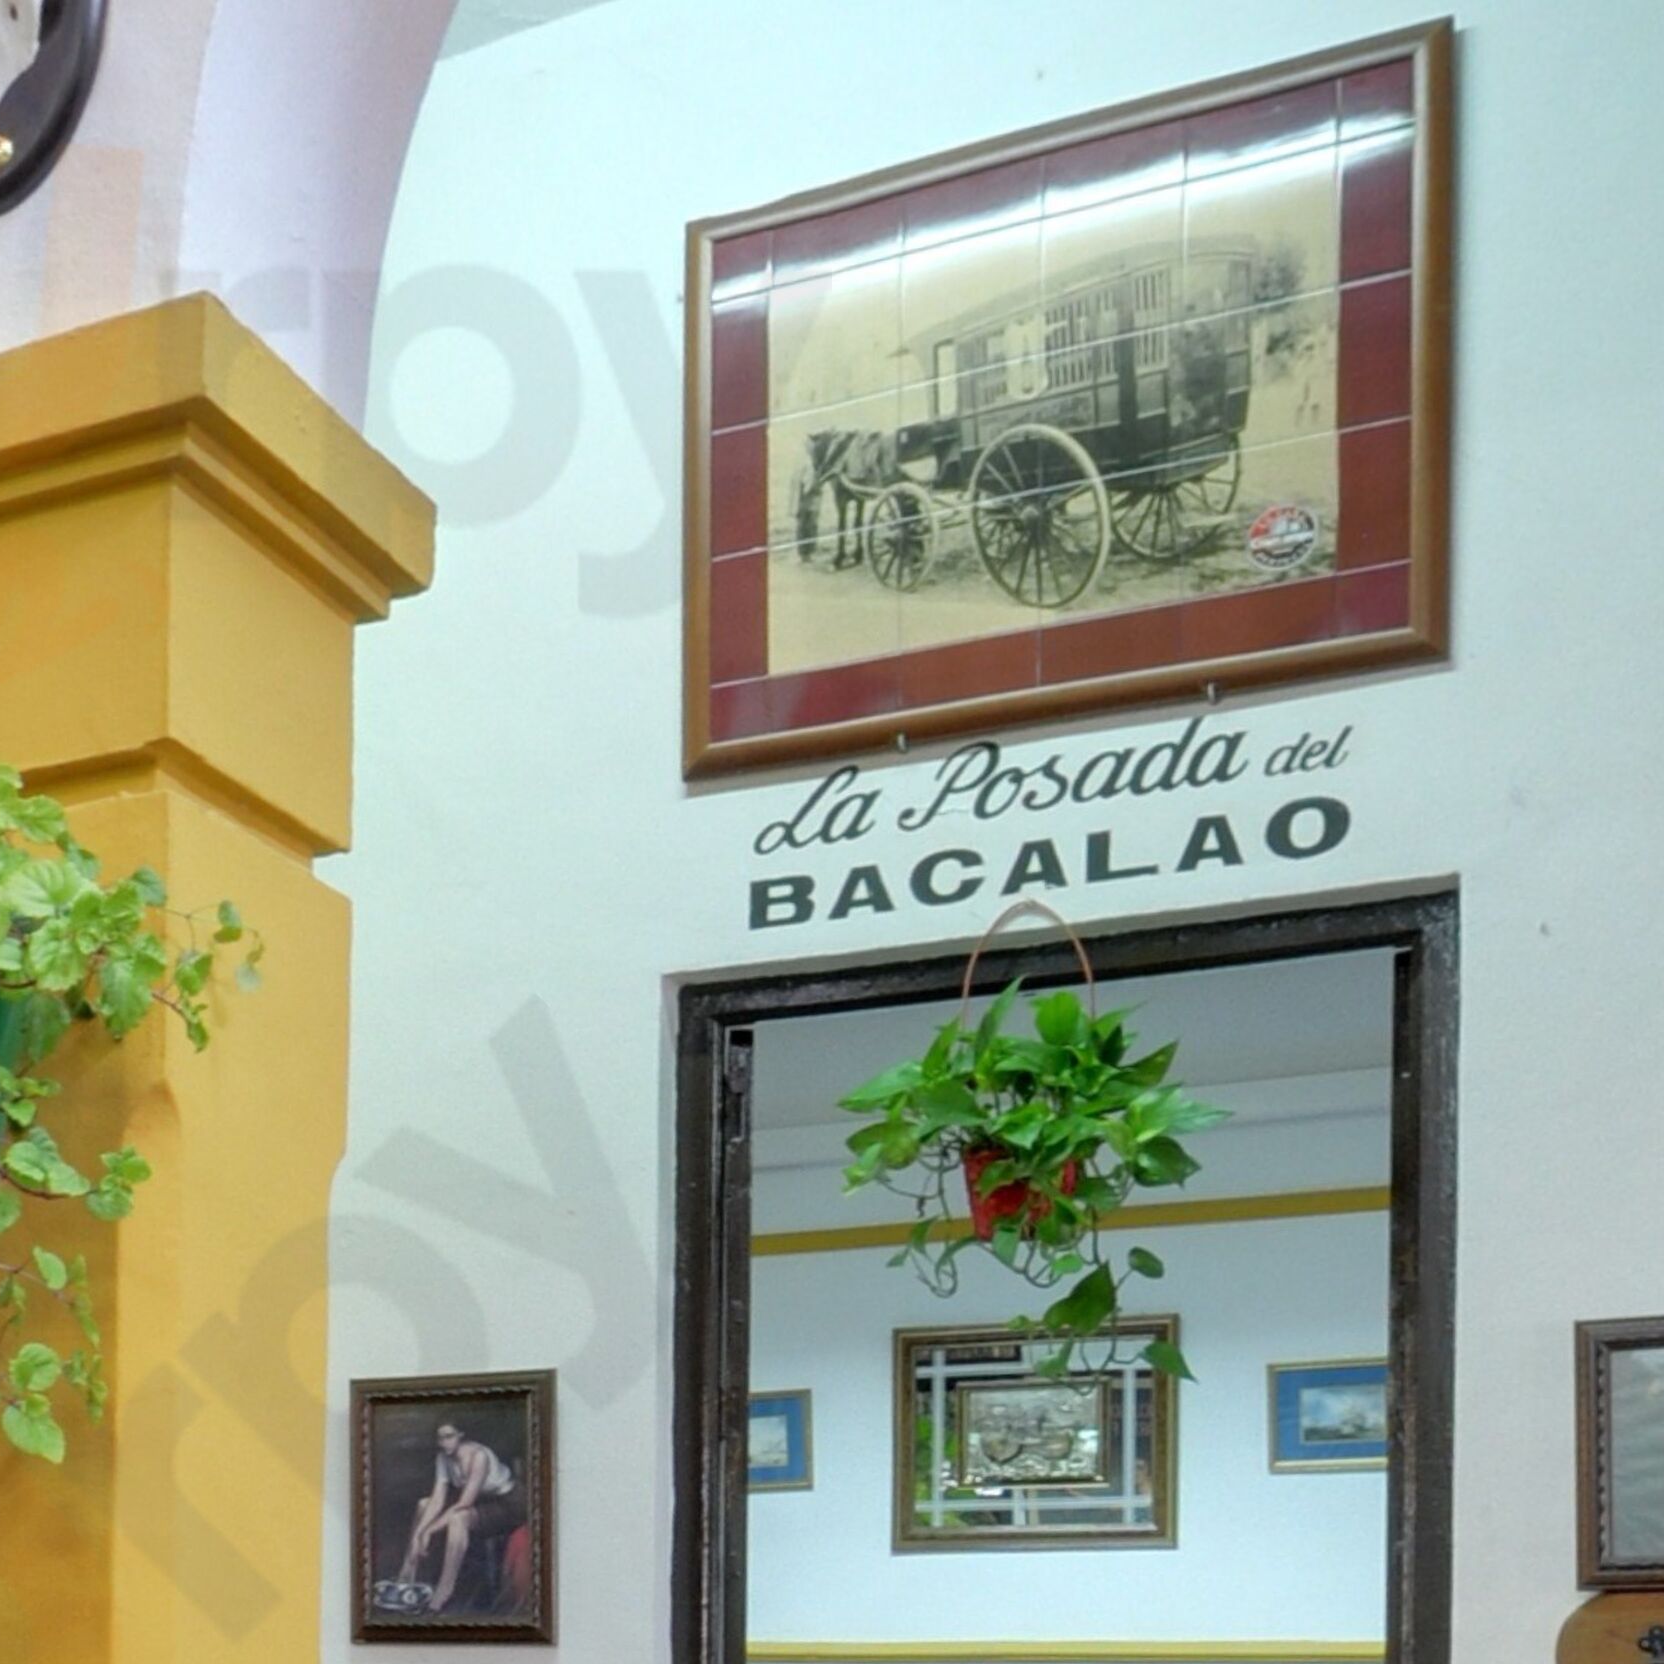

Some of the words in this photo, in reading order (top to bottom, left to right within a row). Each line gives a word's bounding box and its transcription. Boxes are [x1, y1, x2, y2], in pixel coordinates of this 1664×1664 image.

[753, 764, 877, 856] La
[896, 717, 1249, 831] Posada
[1264, 724, 1353, 774] del
[747, 796, 1352, 931] BACALAO
